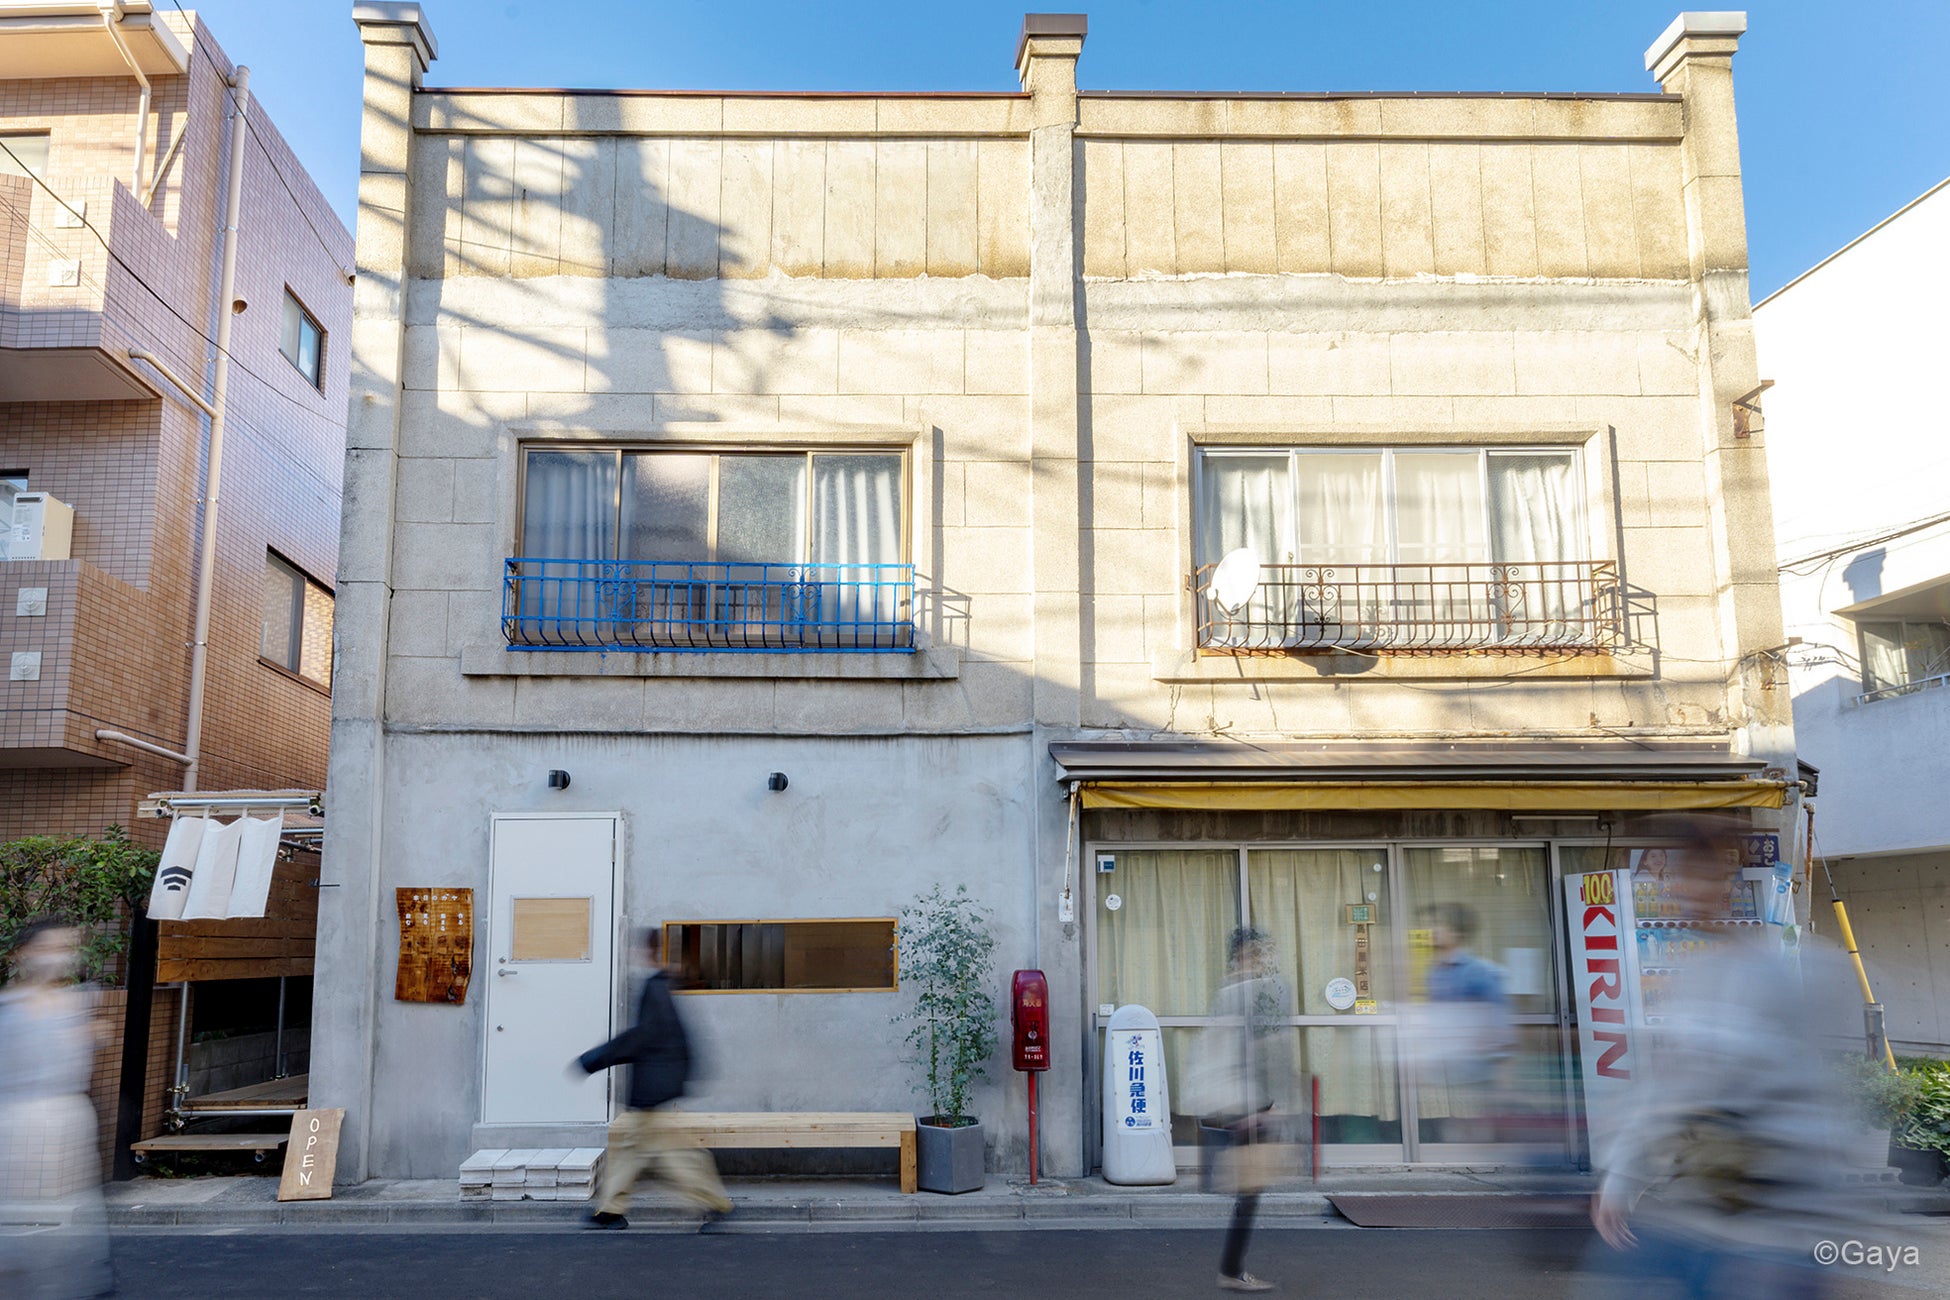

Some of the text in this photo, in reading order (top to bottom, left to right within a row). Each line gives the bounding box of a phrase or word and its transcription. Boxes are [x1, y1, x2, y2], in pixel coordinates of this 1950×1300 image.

[1128, 1050, 1147, 1113] 佐川急便
[299, 1118, 320, 1186] OPEN
